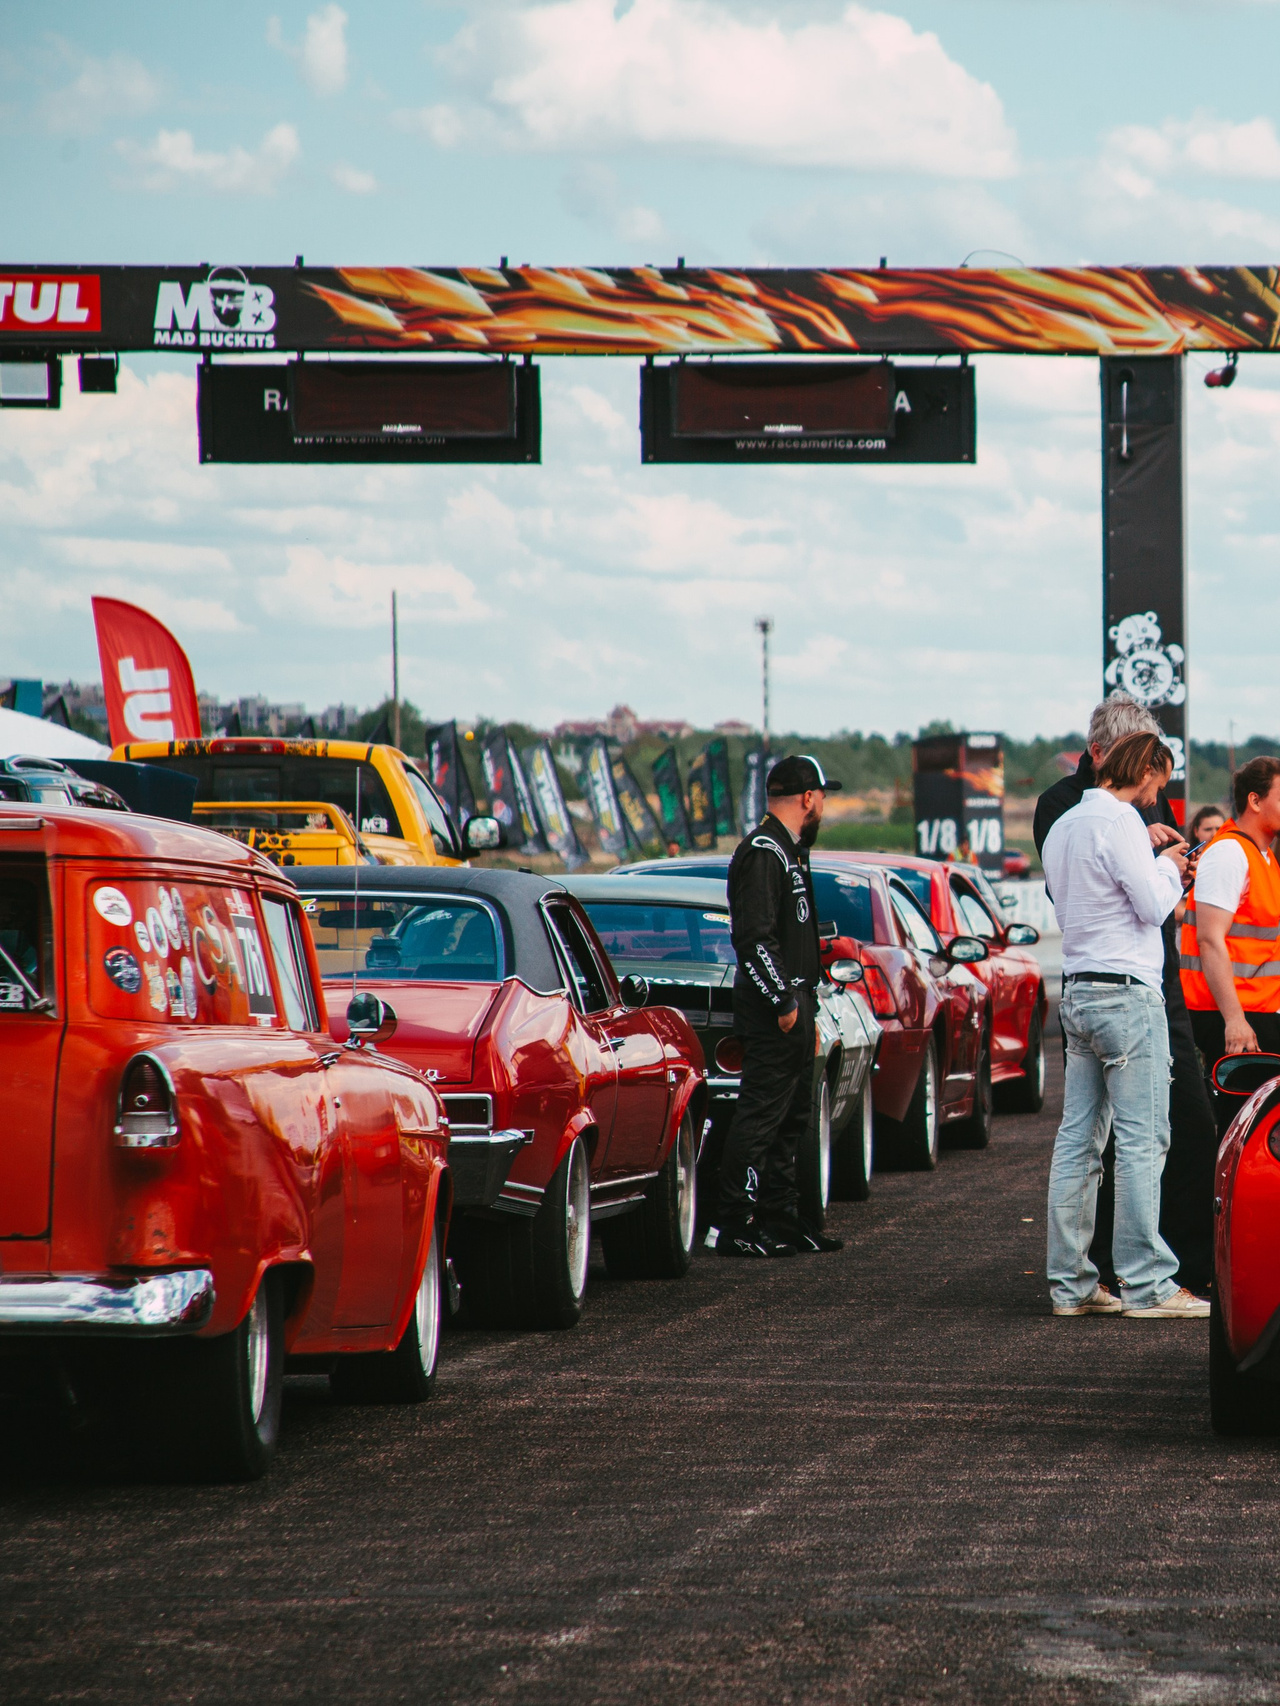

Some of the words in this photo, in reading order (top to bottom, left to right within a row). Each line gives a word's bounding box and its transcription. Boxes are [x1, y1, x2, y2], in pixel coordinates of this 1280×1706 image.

[0, 281, 89, 323] UL
[153, 330, 196, 345] MAD
[199, 332, 276, 348] BUCKETS
[735, 438, 886, 449] www.raceamerica.com
[917, 818, 957, 854] 1/8
[967, 818, 1002, 854] 1/8
